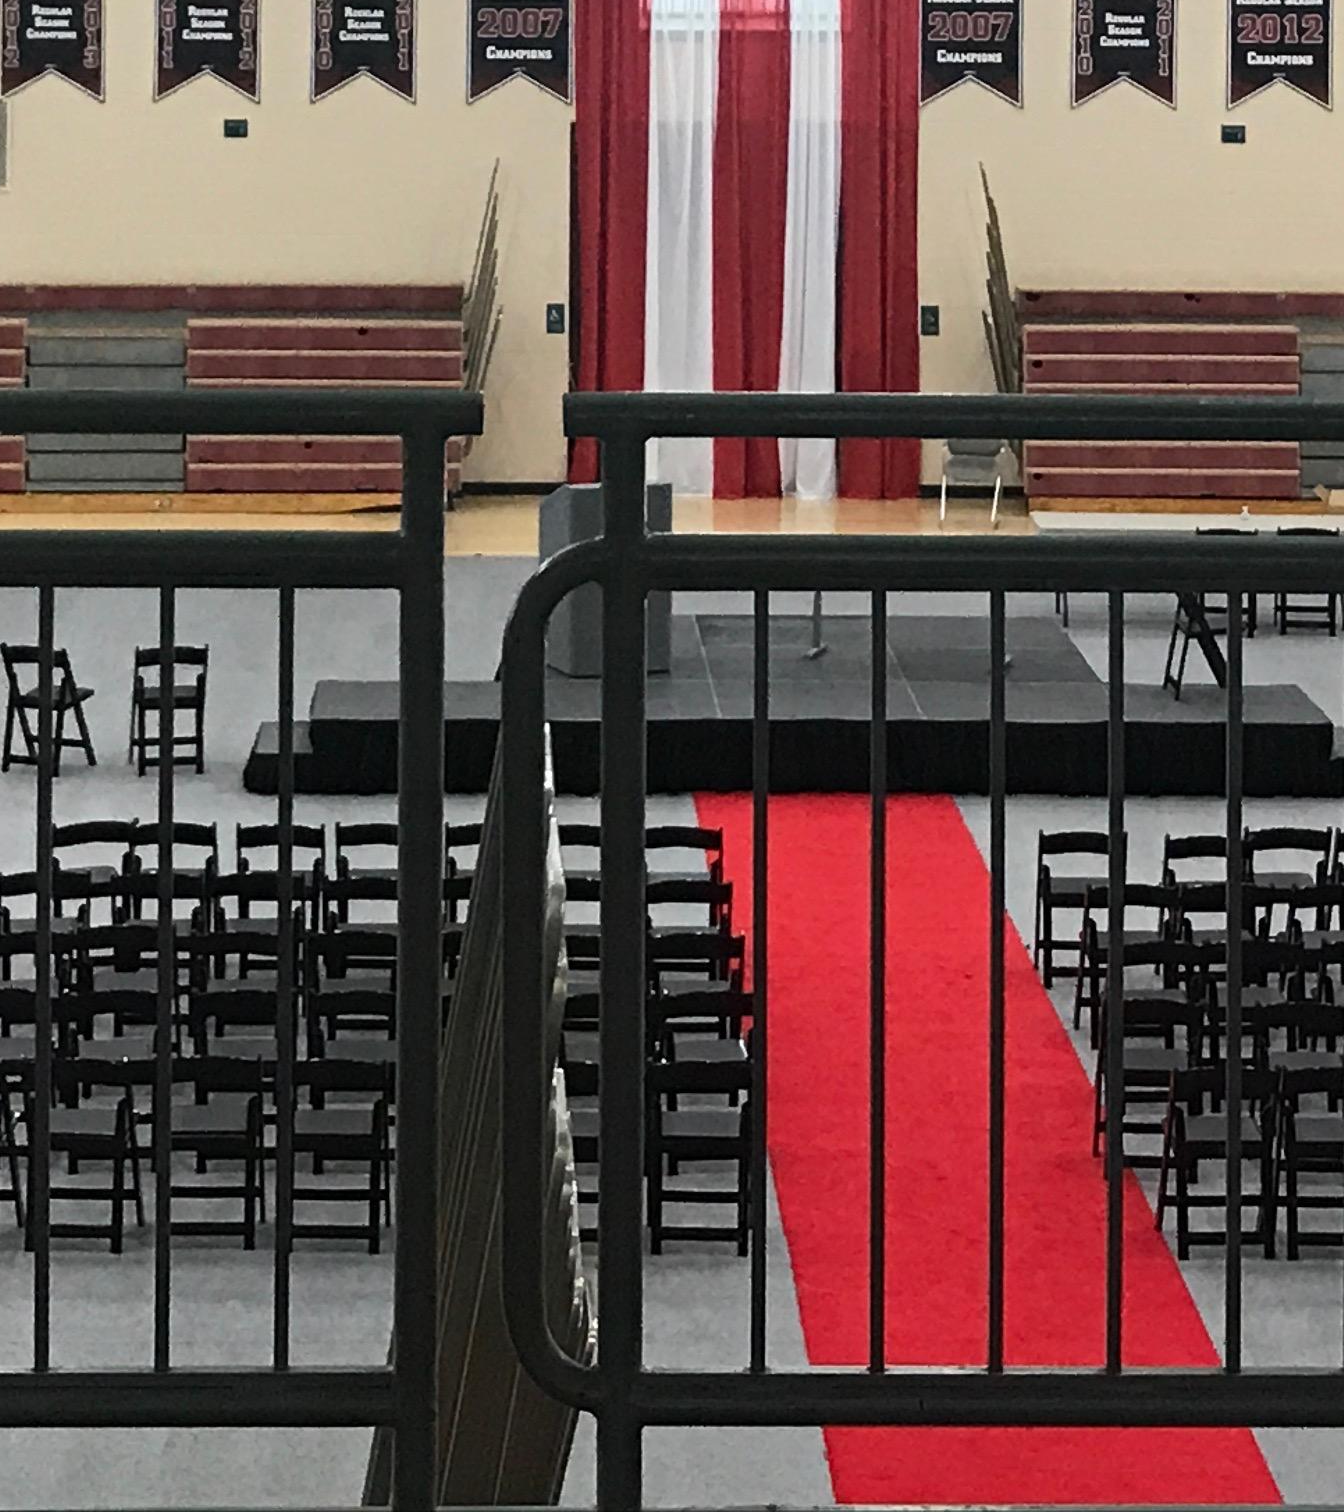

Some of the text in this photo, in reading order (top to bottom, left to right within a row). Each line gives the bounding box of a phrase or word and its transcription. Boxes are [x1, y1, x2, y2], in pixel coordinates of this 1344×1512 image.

[477, 8, 562, 37] 2007
[928, 11, 1013, 41] 2007
[1238, 14, 1323, 44] 2012
